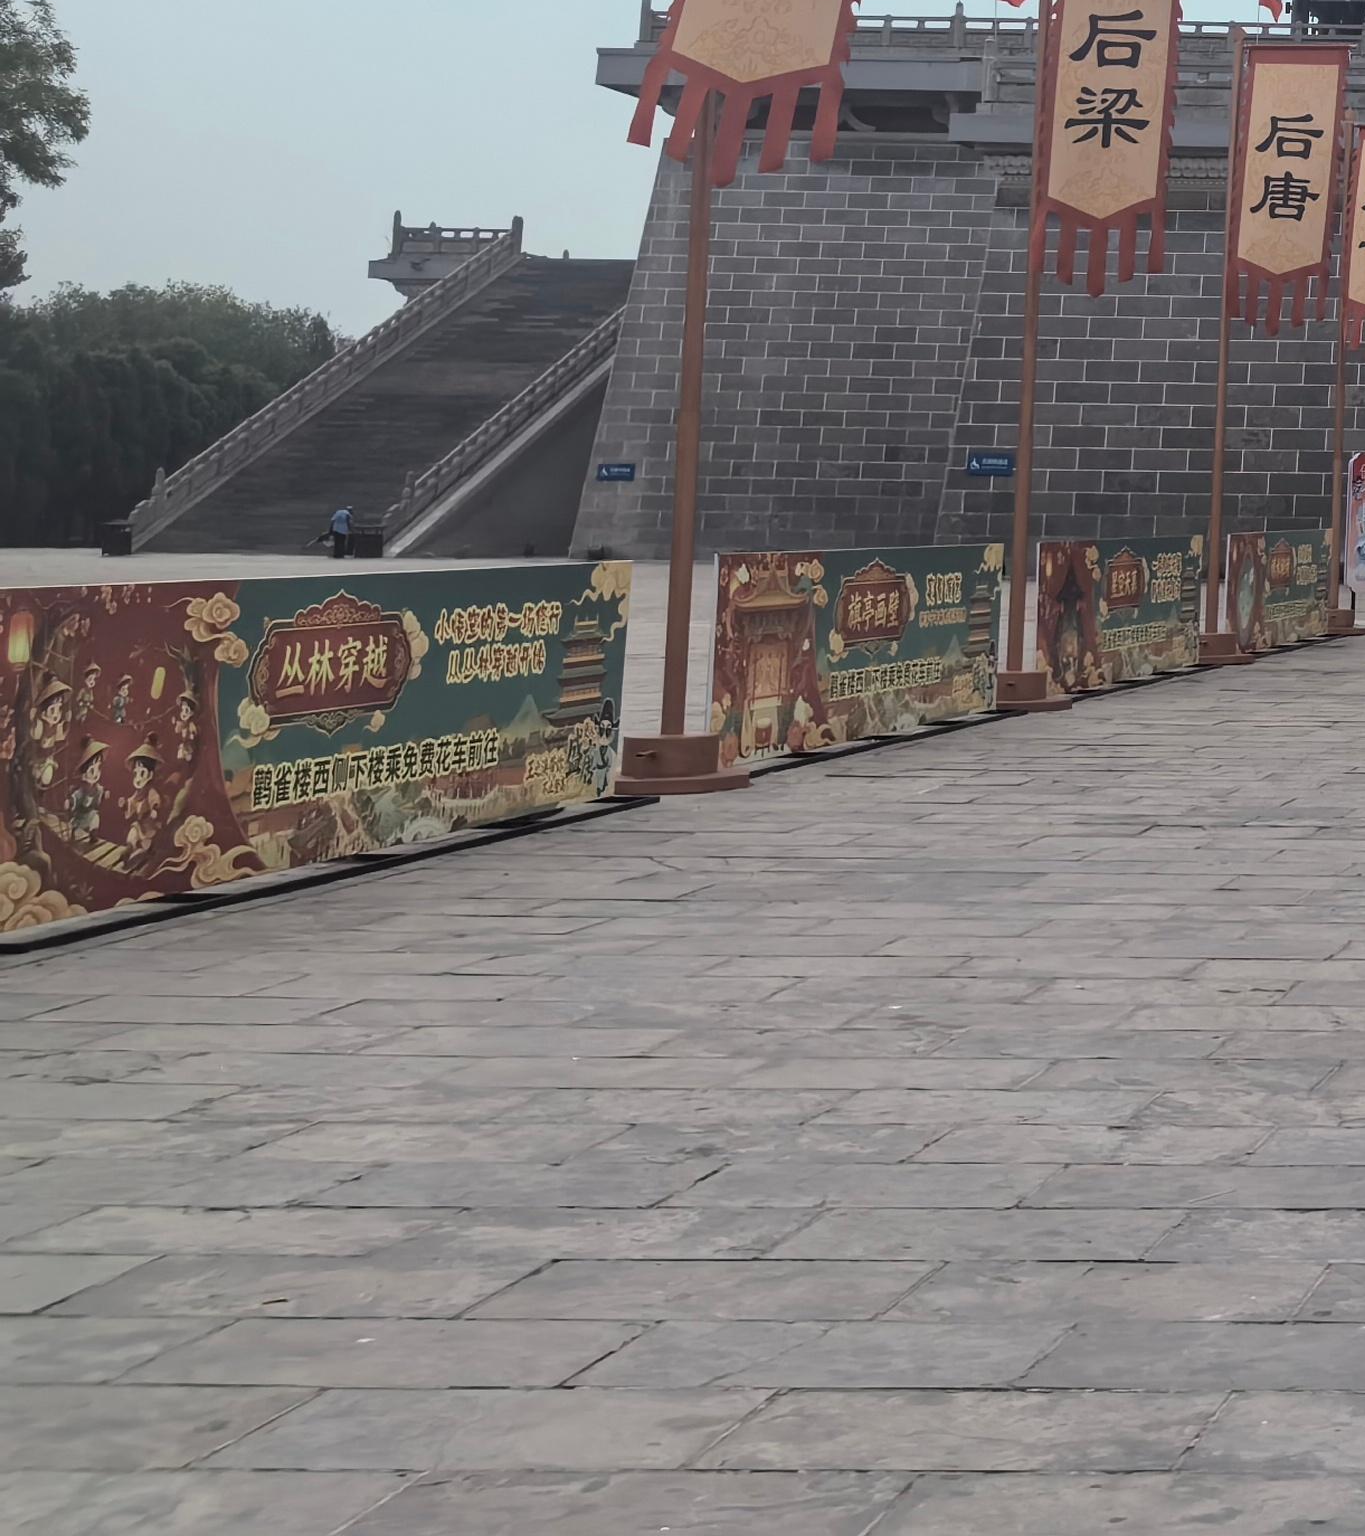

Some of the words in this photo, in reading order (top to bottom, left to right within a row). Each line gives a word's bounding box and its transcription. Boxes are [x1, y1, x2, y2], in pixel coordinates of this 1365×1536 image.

[1064, 9, 1158, 149] 后梁
[1249, 113, 1325, 222] 后唐
[848, 590, 900, 631] 旗亭画壁
[275, 634, 390, 699] 丛林穿越
[251, 729, 498, 811] 鹳雀楼西侧下楼乘免费花车前往
